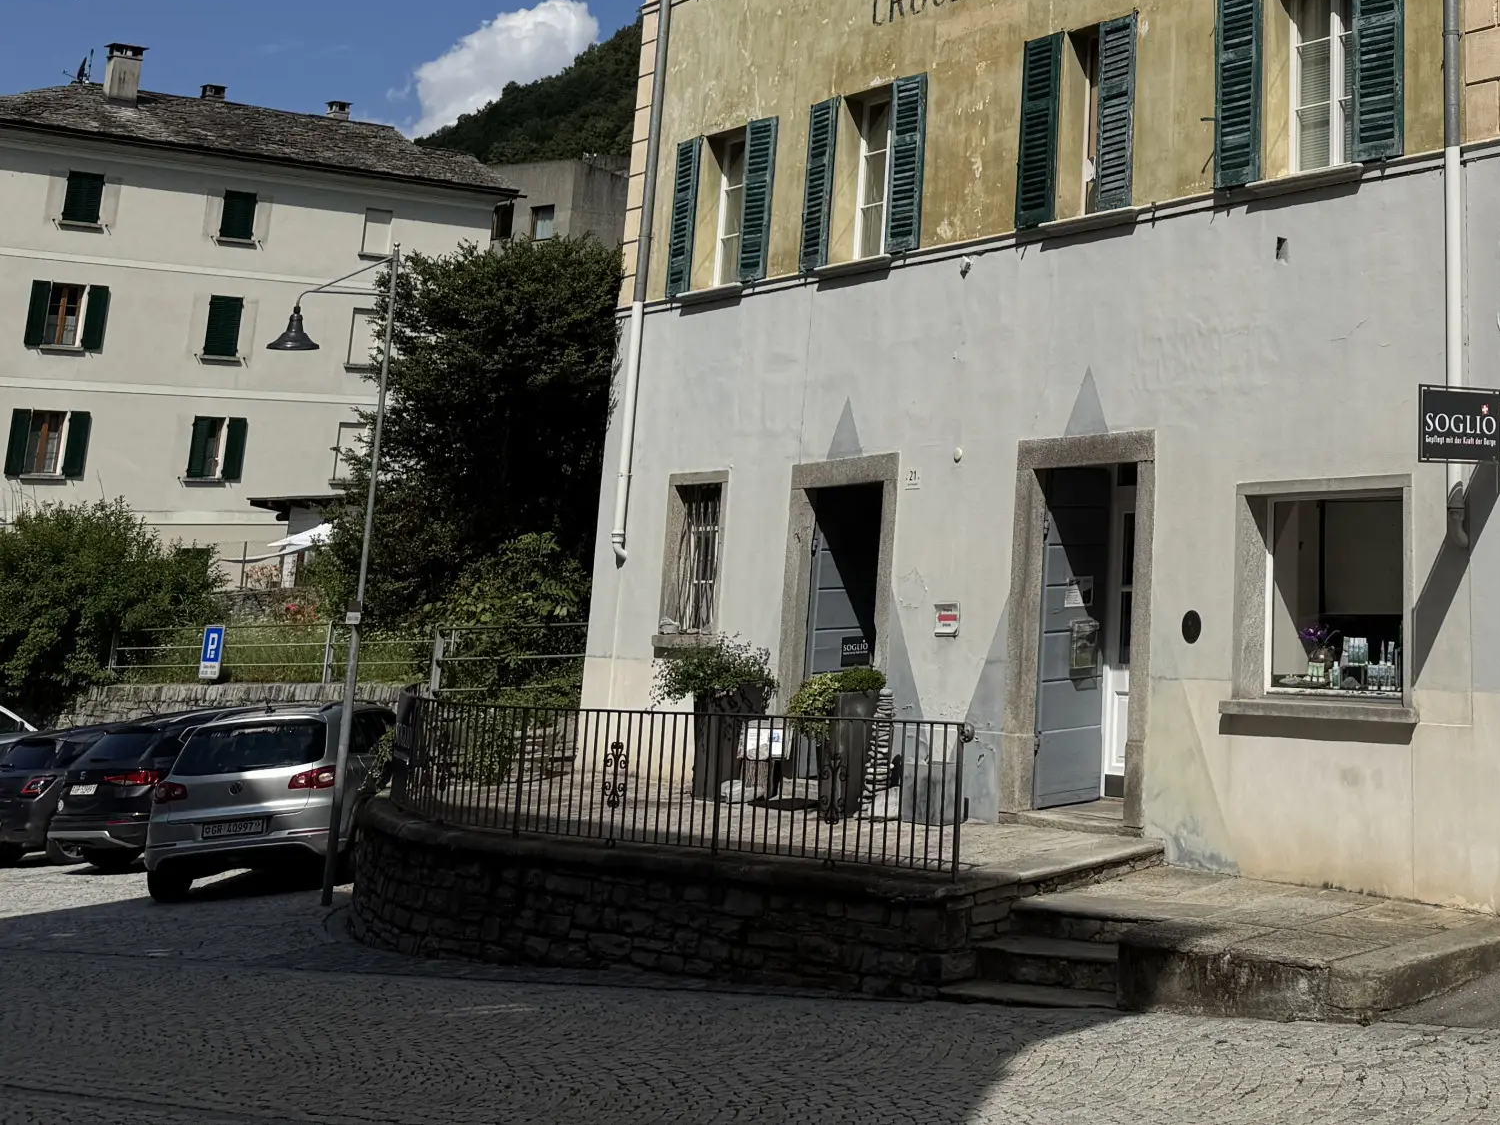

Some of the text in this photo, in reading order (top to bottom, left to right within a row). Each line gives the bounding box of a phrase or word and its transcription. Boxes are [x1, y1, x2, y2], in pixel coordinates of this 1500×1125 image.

[1425, 412, 1497, 435] SOGLIO
[1425, 434, 1496, 447] Gepflegt mit der Kraft der Berge
[909, 470, 917, 481] 21
[207, 633, 218, 659] P
[843, 643, 868, 651] SOGLIO
[211, 825, 223, 835] GR
